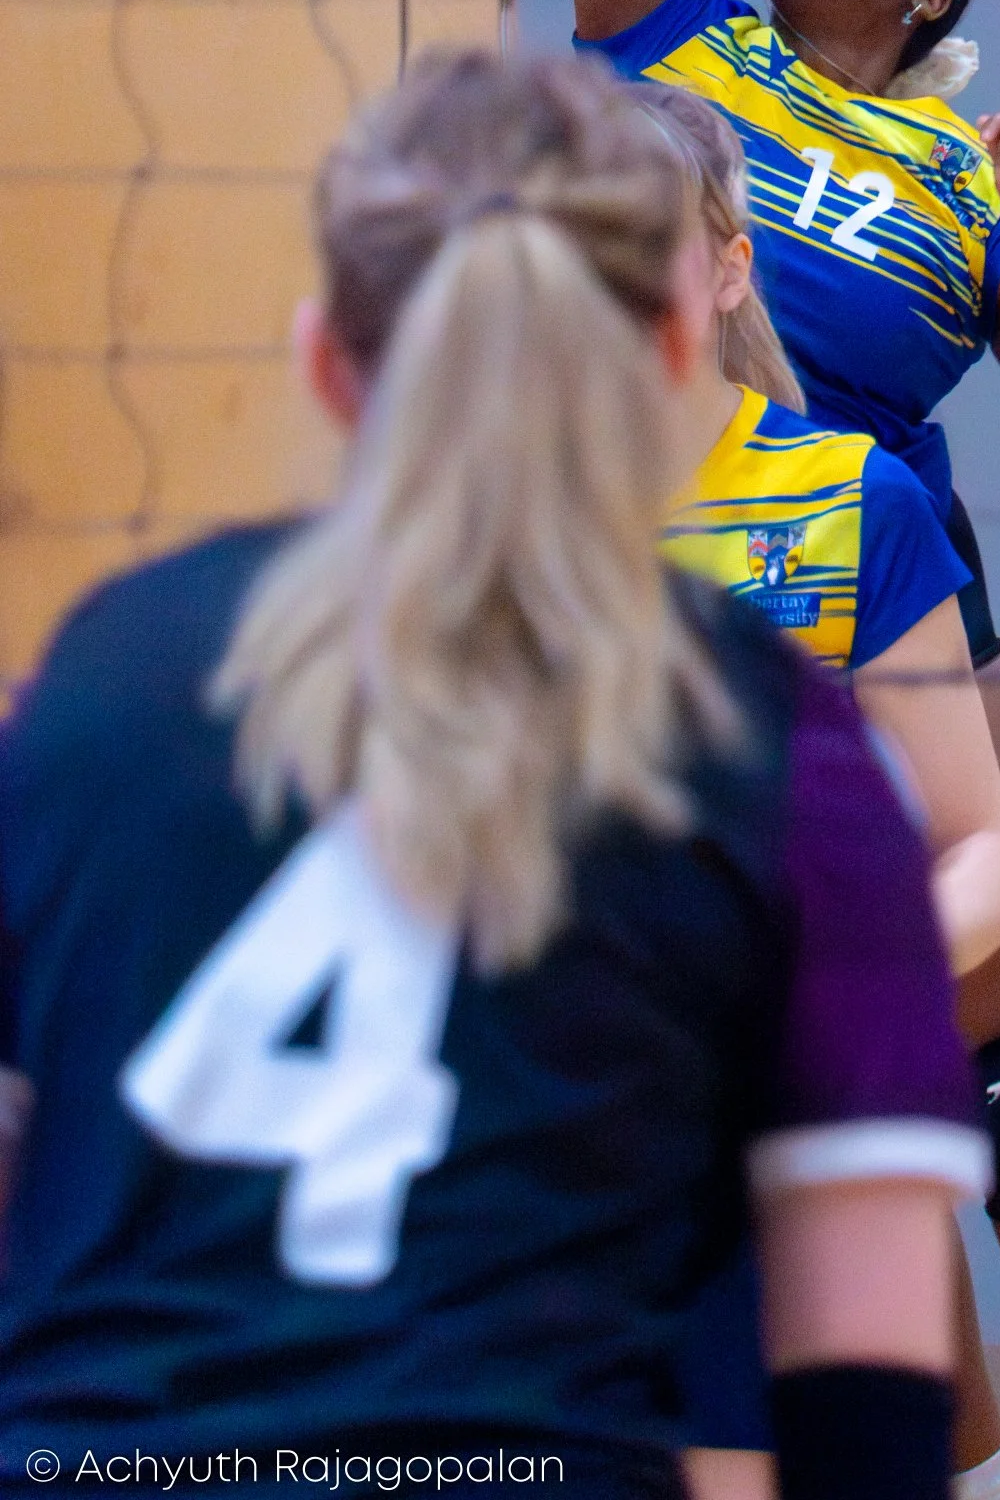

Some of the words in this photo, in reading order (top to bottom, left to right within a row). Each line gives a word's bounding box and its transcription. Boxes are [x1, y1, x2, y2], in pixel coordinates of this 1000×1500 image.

[793, 147, 894, 261] 12
[750, 595, 811, 610] bertay
[118, 800, 460, 1288] 4
